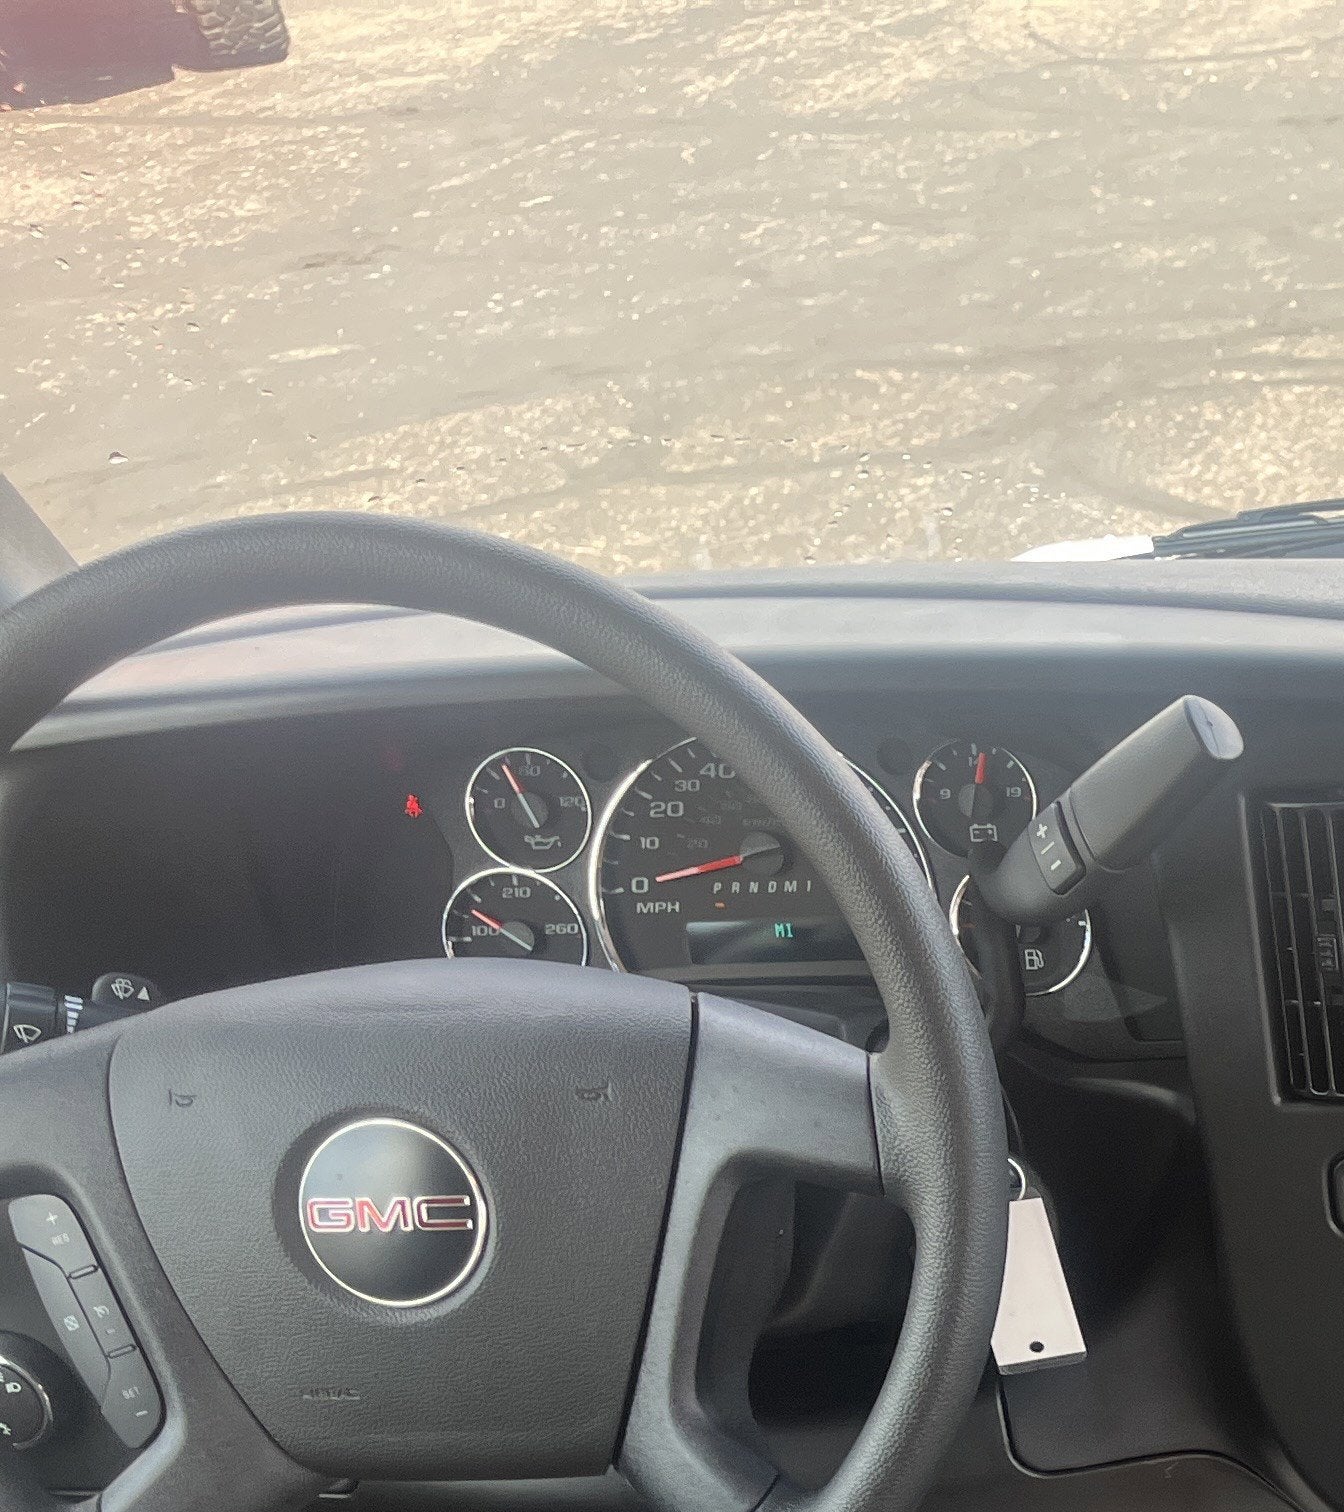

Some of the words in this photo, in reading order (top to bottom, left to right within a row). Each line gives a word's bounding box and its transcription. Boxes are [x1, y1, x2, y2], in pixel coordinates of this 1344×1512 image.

[674, 779, 700, 792] 30
[1006, 786, 1022, 798] 19
[649, 801, 684, 818] 20
[640, 837, 659, 850] 10
[631, 877, 649, 894] 0
[502, 887, 531, 899] 210
[636, 901, 680, 914] MPH
[472, 926, 500, 937] 100
[545, 923, 579, 935] 260
[306, 1195, 473, 1233] GMC
